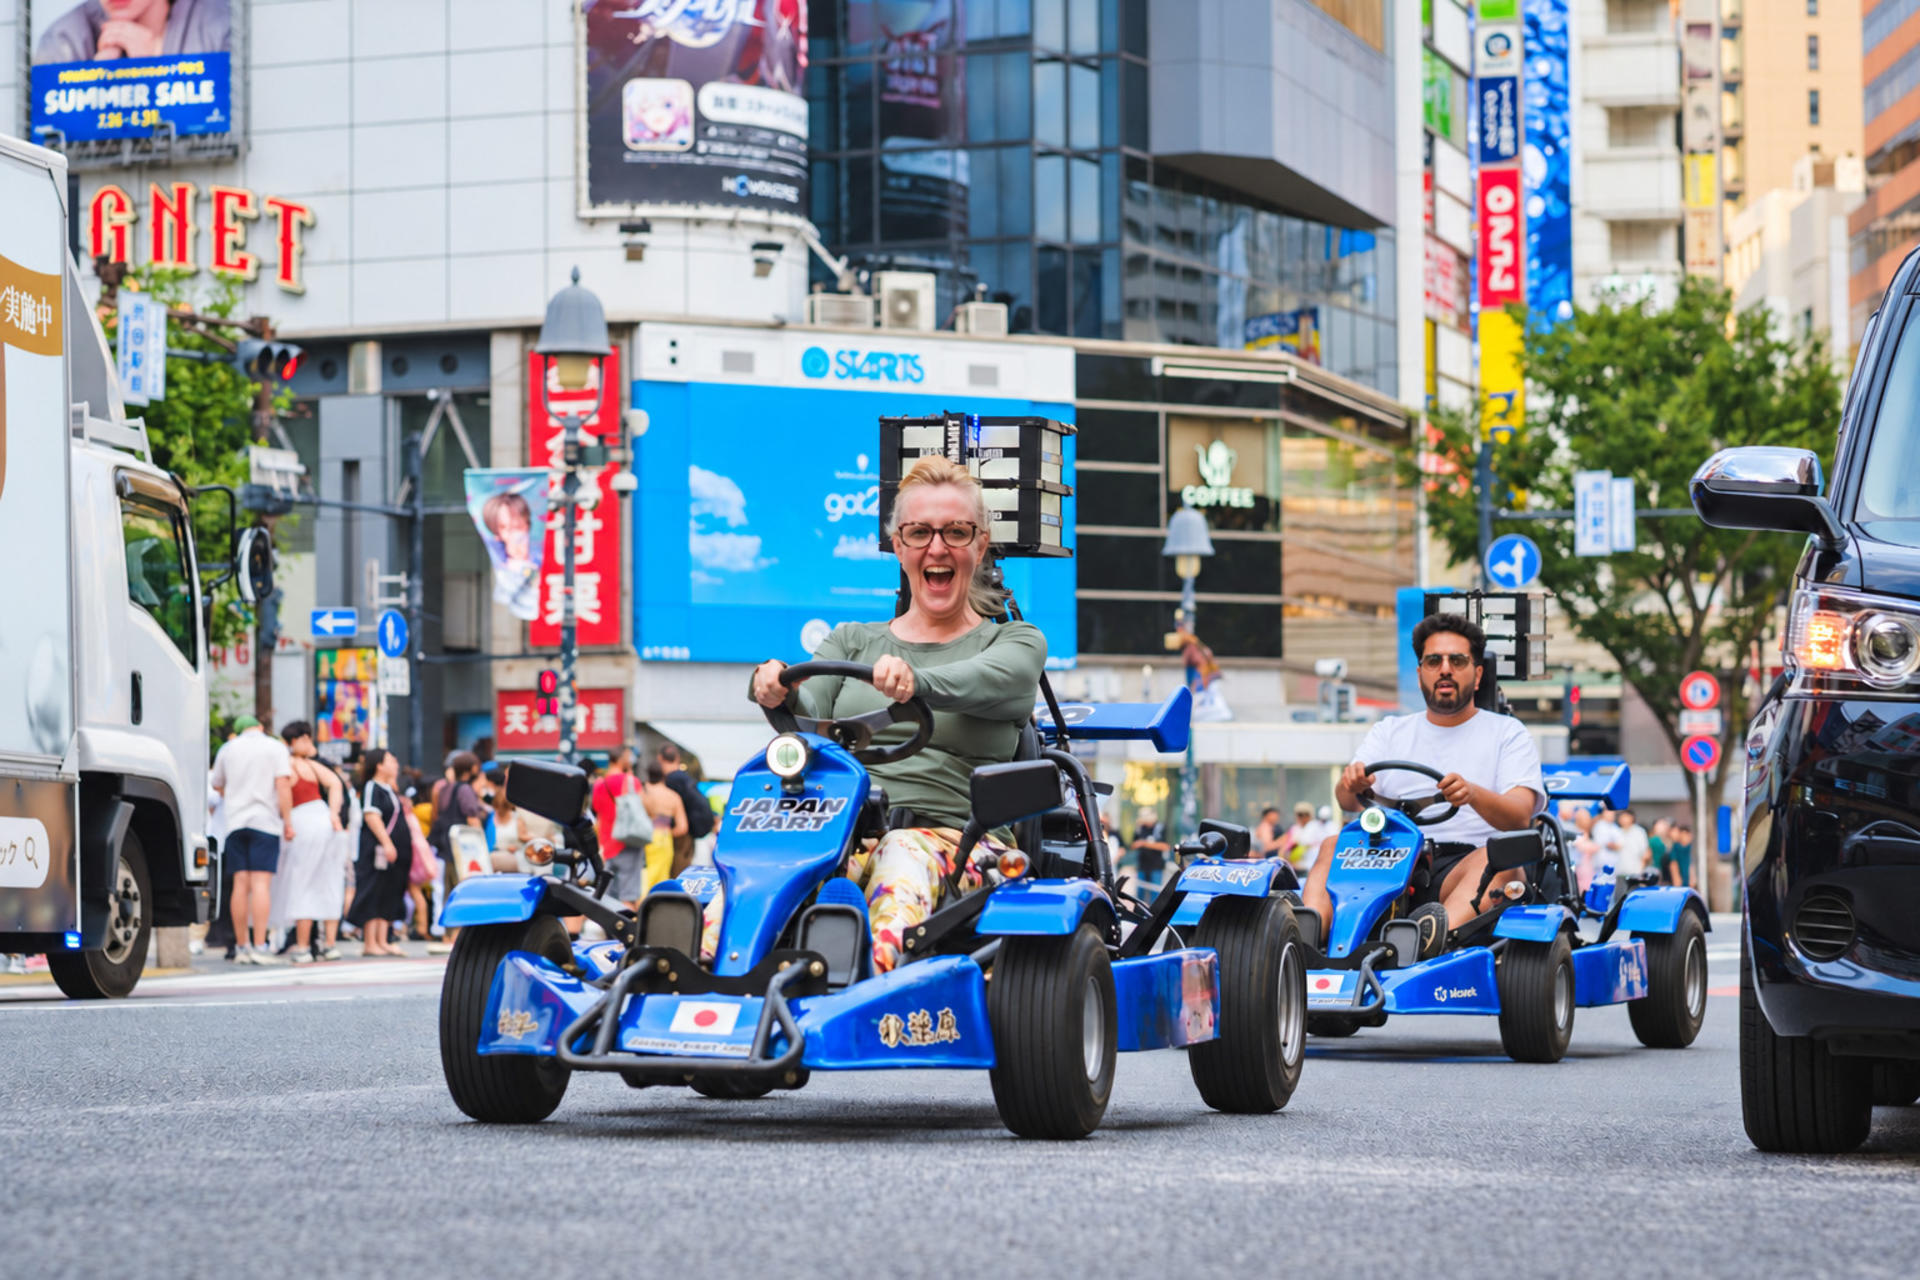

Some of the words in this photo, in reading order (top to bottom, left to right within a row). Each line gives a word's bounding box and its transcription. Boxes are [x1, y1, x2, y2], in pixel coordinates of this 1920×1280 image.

[44, 84, 150, 115] SUMMER
[154, 80, 215, 107] SALE
[834, 349, 925, 384] STARTS
[1181, 484, 1255, 508] COFFEE
[503, 703, 617, 734] 天甘栗
[730, 797, 848, 816] JAPAN
[736, 812, 834, 832] KART
[1336, 847, 1411, 859] JAPAN
[1341, 858, 1397, 870] KART
